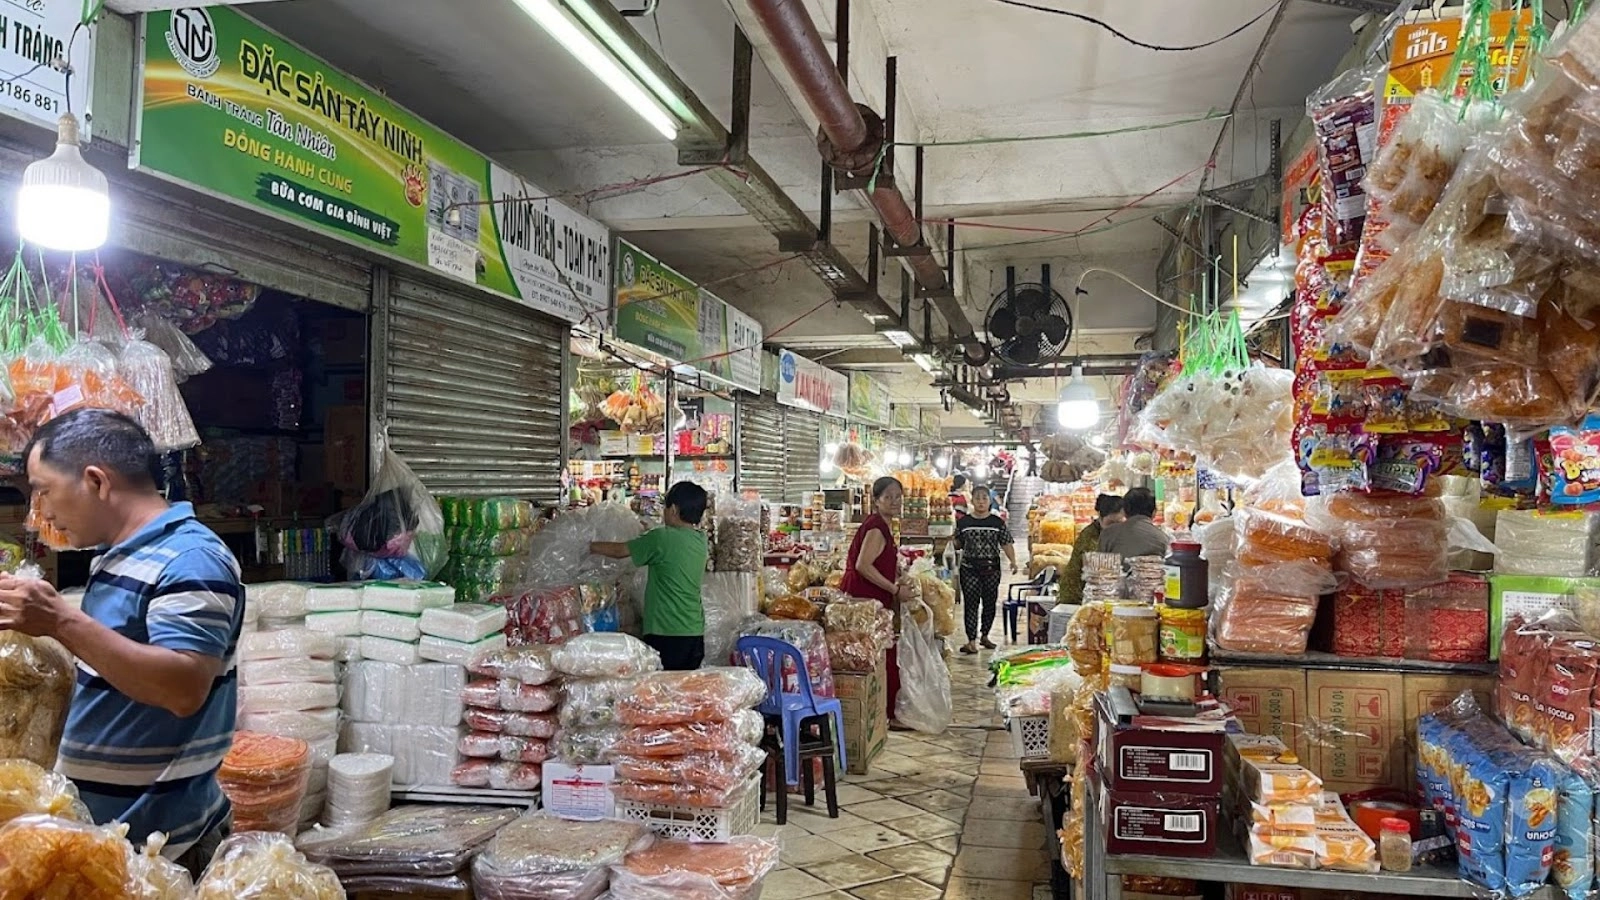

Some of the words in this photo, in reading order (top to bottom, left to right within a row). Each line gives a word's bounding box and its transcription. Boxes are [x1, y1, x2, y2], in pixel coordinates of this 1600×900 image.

[34, 93, 59, 114] 881
[241, 43, 291, 97] ĐẶC
[297, 72, 341, 123] SẢN
[345, 99, 381, 141] TÂY
[384, 120, 422, 165] NINH
[224, 129, 271, 161] ĐỒNG
[267, 109, 293, 140] Tân
[297, 124, 336, 159] Nhiên
[271, 181, 295, 202] BỮA
[298, 192, 324, 213] CƠM
[326, 203, 344, 220] GIA
[346, 210, 370, 230] ĐÌNH
[372, 220, 392, 240] VIỆT
[1332, 690, 1344, 700] 10
[1334, 753, 1345, 767] 500
